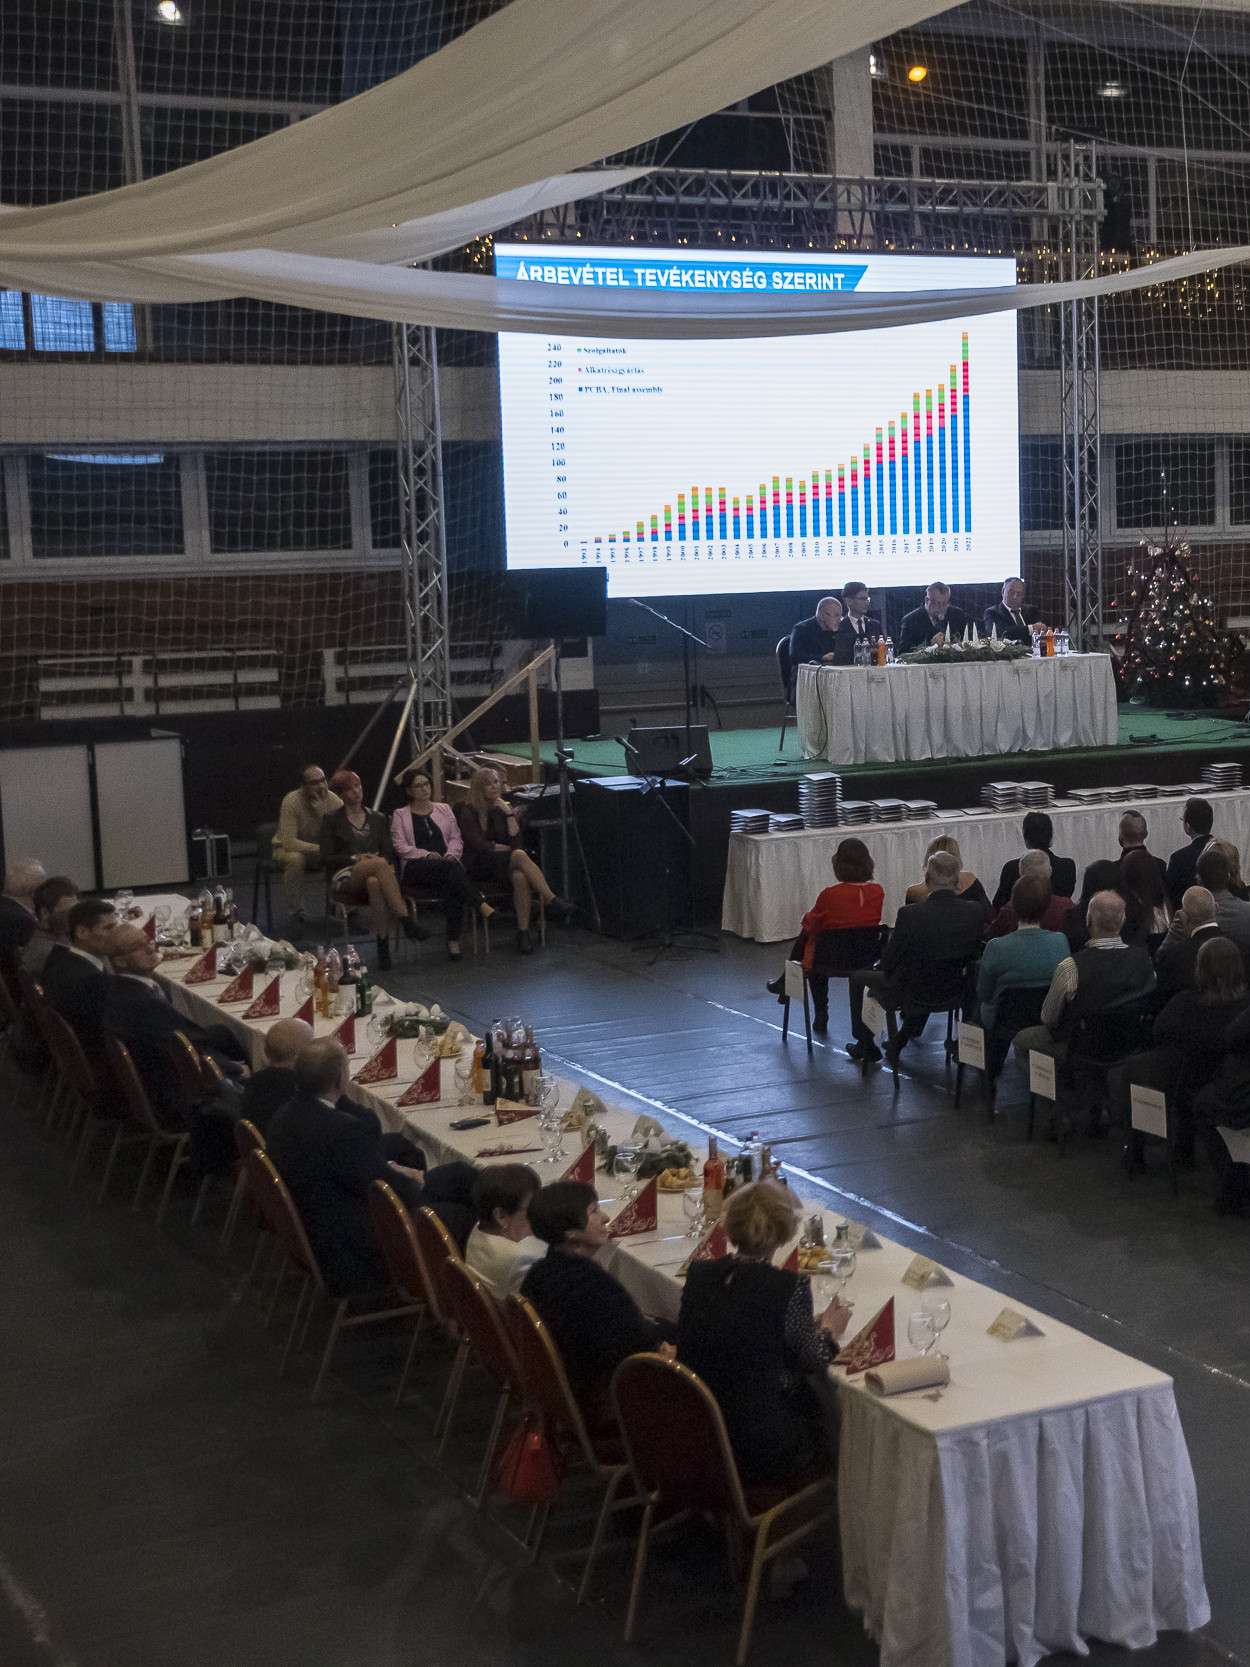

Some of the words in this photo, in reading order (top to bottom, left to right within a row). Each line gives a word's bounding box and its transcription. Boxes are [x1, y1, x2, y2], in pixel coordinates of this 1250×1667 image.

[517, 261, 629, 285] ÁRBEVÉTEL
[633, 265, 767, 289] TEVÉKENYSÉG
[771, 272, 845, 291] SZERINT
[548, 343, 561, 351] 240
[631, 386, 664, 396] assembly
[550, 393, 563, 401] 180
[550, 409, 564, 417] 160
[552, 442, 565, 450] 120
[552, 458, 566, 466] 100
[557, 491, 567, 500] 60
[558, 507, 567, 515] 40
[559, 524, 568, 532] 20
